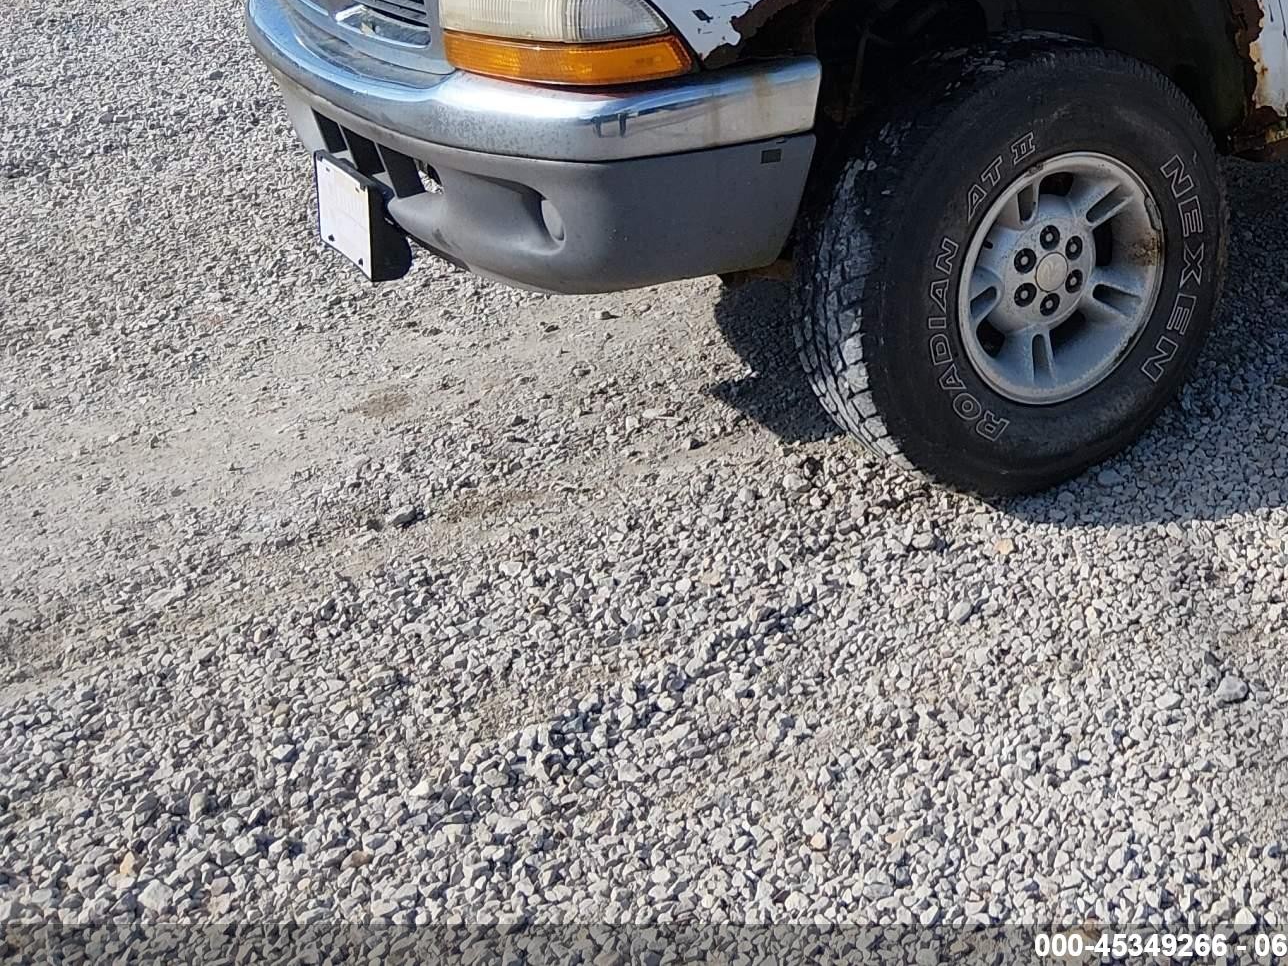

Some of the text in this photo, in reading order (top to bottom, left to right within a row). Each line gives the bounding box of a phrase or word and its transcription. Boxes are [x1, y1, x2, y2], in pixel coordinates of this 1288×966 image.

[967, 155, 1003, 224] AT
[1141, 154, 1205, 383] NEXEN
[928, 237, 1010, 441] ROADIAN
